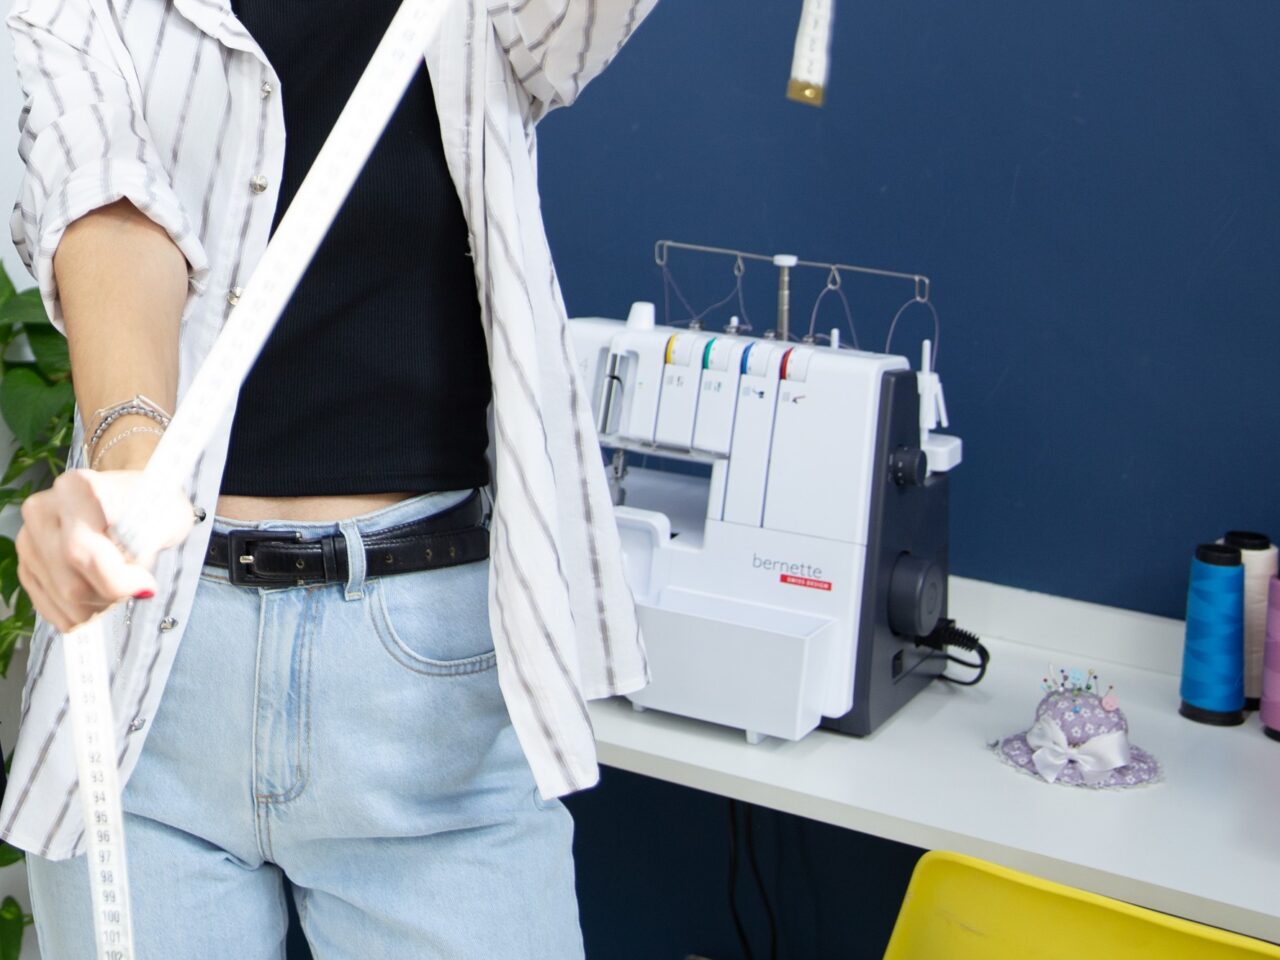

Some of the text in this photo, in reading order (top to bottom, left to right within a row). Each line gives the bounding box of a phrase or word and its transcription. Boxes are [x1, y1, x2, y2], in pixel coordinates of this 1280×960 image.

[752, 552, 823, 578] bernette
[88, 752, 103, 765] 92
[90, 771, 105, 784] 93
[92, 791, 107, 804] 94
[94, 810, 109, 824] 95
[96, 830, 111, 844] 96
[98, 850, 112, 863] 97
[100, 870, 115, 884] 98
[102, 889, 117, 903] 99
[103, 909, 121, 924] 100
[104, 929, 121, 944] 101
